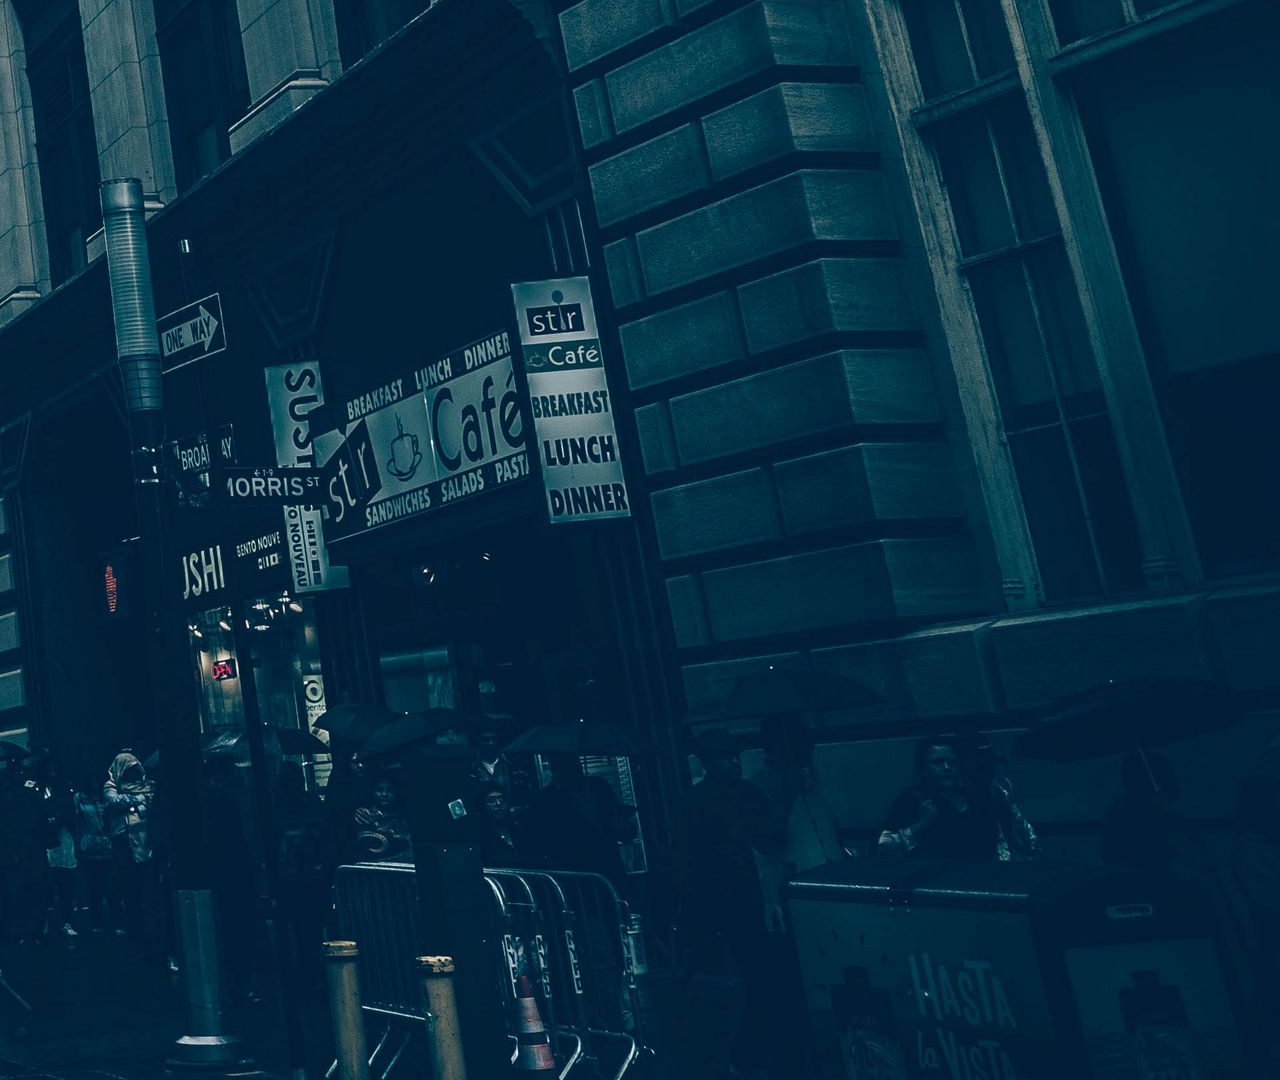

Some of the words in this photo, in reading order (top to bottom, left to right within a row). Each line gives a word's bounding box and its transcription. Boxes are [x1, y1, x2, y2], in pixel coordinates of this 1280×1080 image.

[532, 295, 577, 334] stir
[165, 326, 185, 353] ONE
[190, 316, 213, 343] WAY
[548, 345, 600, 366] Café
[346, 378, 403, 421] BREAKFAST
[415, 358, 453, 390] LUNCH
[464, 331, 511, 370] DINNER
[432, 371, 527, 472] Café
[531, 390, 609, 419] BREAKFAST
[543, 435, 617, 467] LUNCH
[306, 476, 321, 487] ST
[366, 488, 431, 527] SANDWICHES
[441, 469, 485, 503] SALADS
[549, 483, 629, 517] DINNER
[236, 540, 257, 558] BENTO
[290, 523, 308, 587] NOUVEAU
[907, 952, 1018, 1030] HASTA
